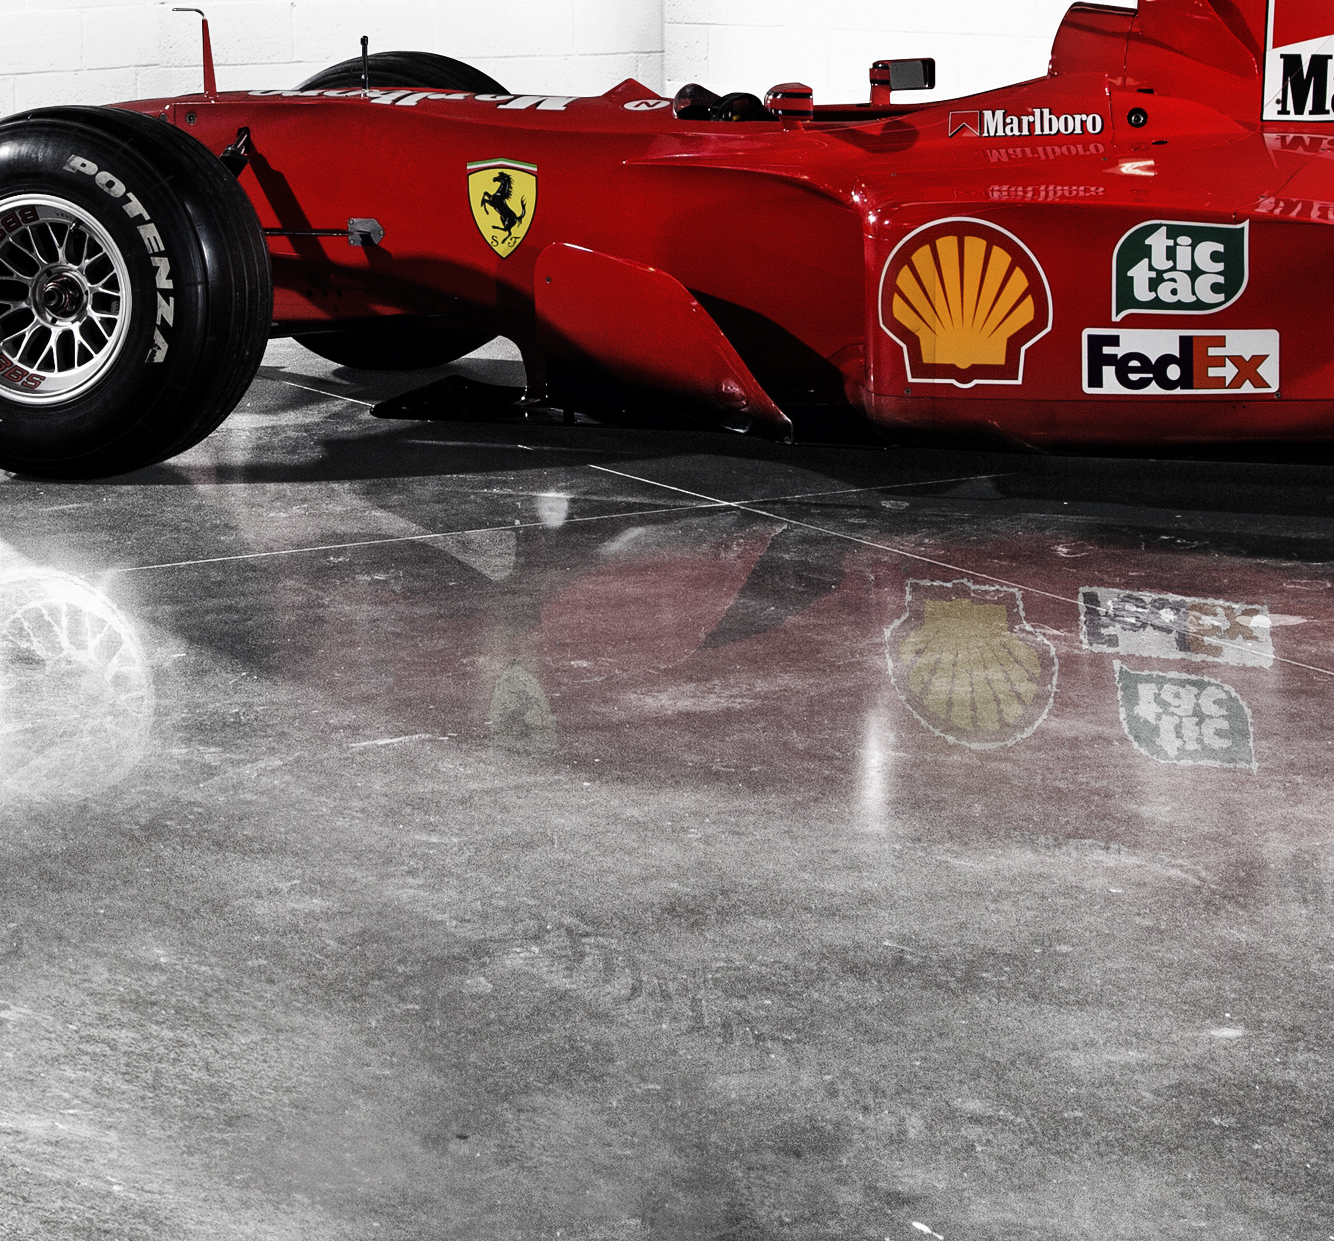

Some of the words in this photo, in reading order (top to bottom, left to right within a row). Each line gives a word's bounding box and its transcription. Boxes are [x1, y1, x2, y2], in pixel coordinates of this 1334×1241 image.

[982, 108, 1104, 137] Marlboro
[62, 154, 175, 363] POTENZA
[1145, 226, 1224, 273] tic
[1127, 258, 1225, 304] tac
[1087, 334, 1272, 391] FedEx
